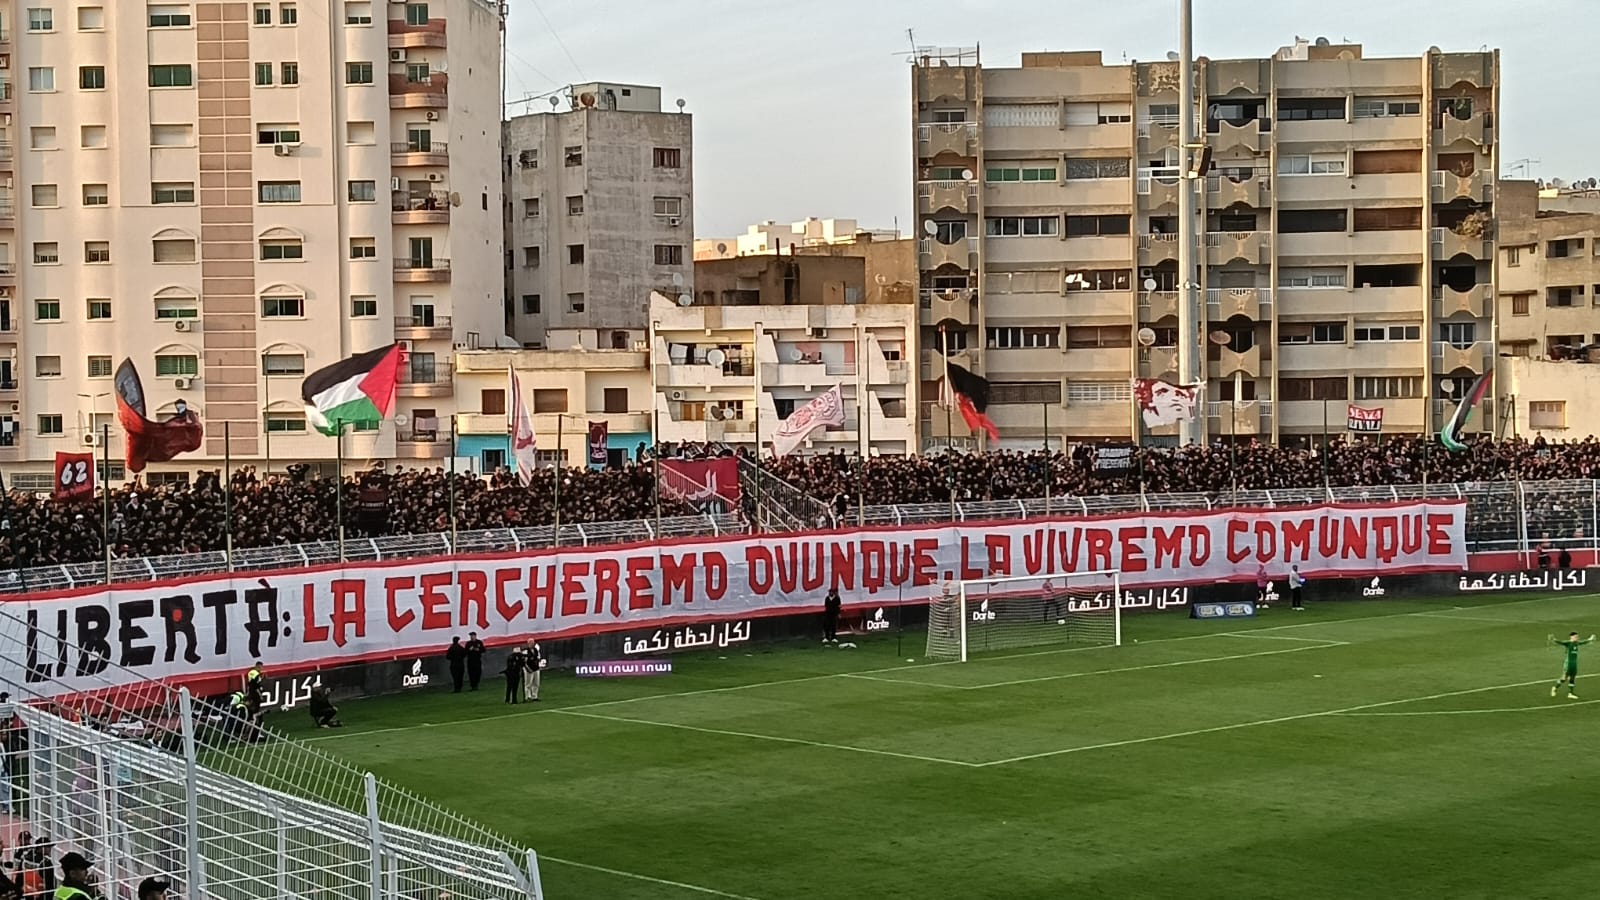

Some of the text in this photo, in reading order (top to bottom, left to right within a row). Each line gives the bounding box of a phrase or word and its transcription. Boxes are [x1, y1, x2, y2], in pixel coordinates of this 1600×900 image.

[61, 461, 88, 485] 62
[304, 580, 365, 646] LA
[385, 552, 727, 631] CERCHEREMO
[960, 534, 1011, 586] LA
[1023, 526, 1211, 578] VIVREMO
[1228, 514, 1455, 565] COMUNQUE
[1459, 570, 1586, 591] لكل لحظة نكهة
[1067, 592, 1111, 612] نكهة
[1156, 588, 1188, 610] لكل
[1362, 587, 1385, 597] Dante
[866, 619, 890, 631] Dante
[623, 621, 751, 655] لكل لحظة نكهة
[402, 673, 429, 687] Dante
